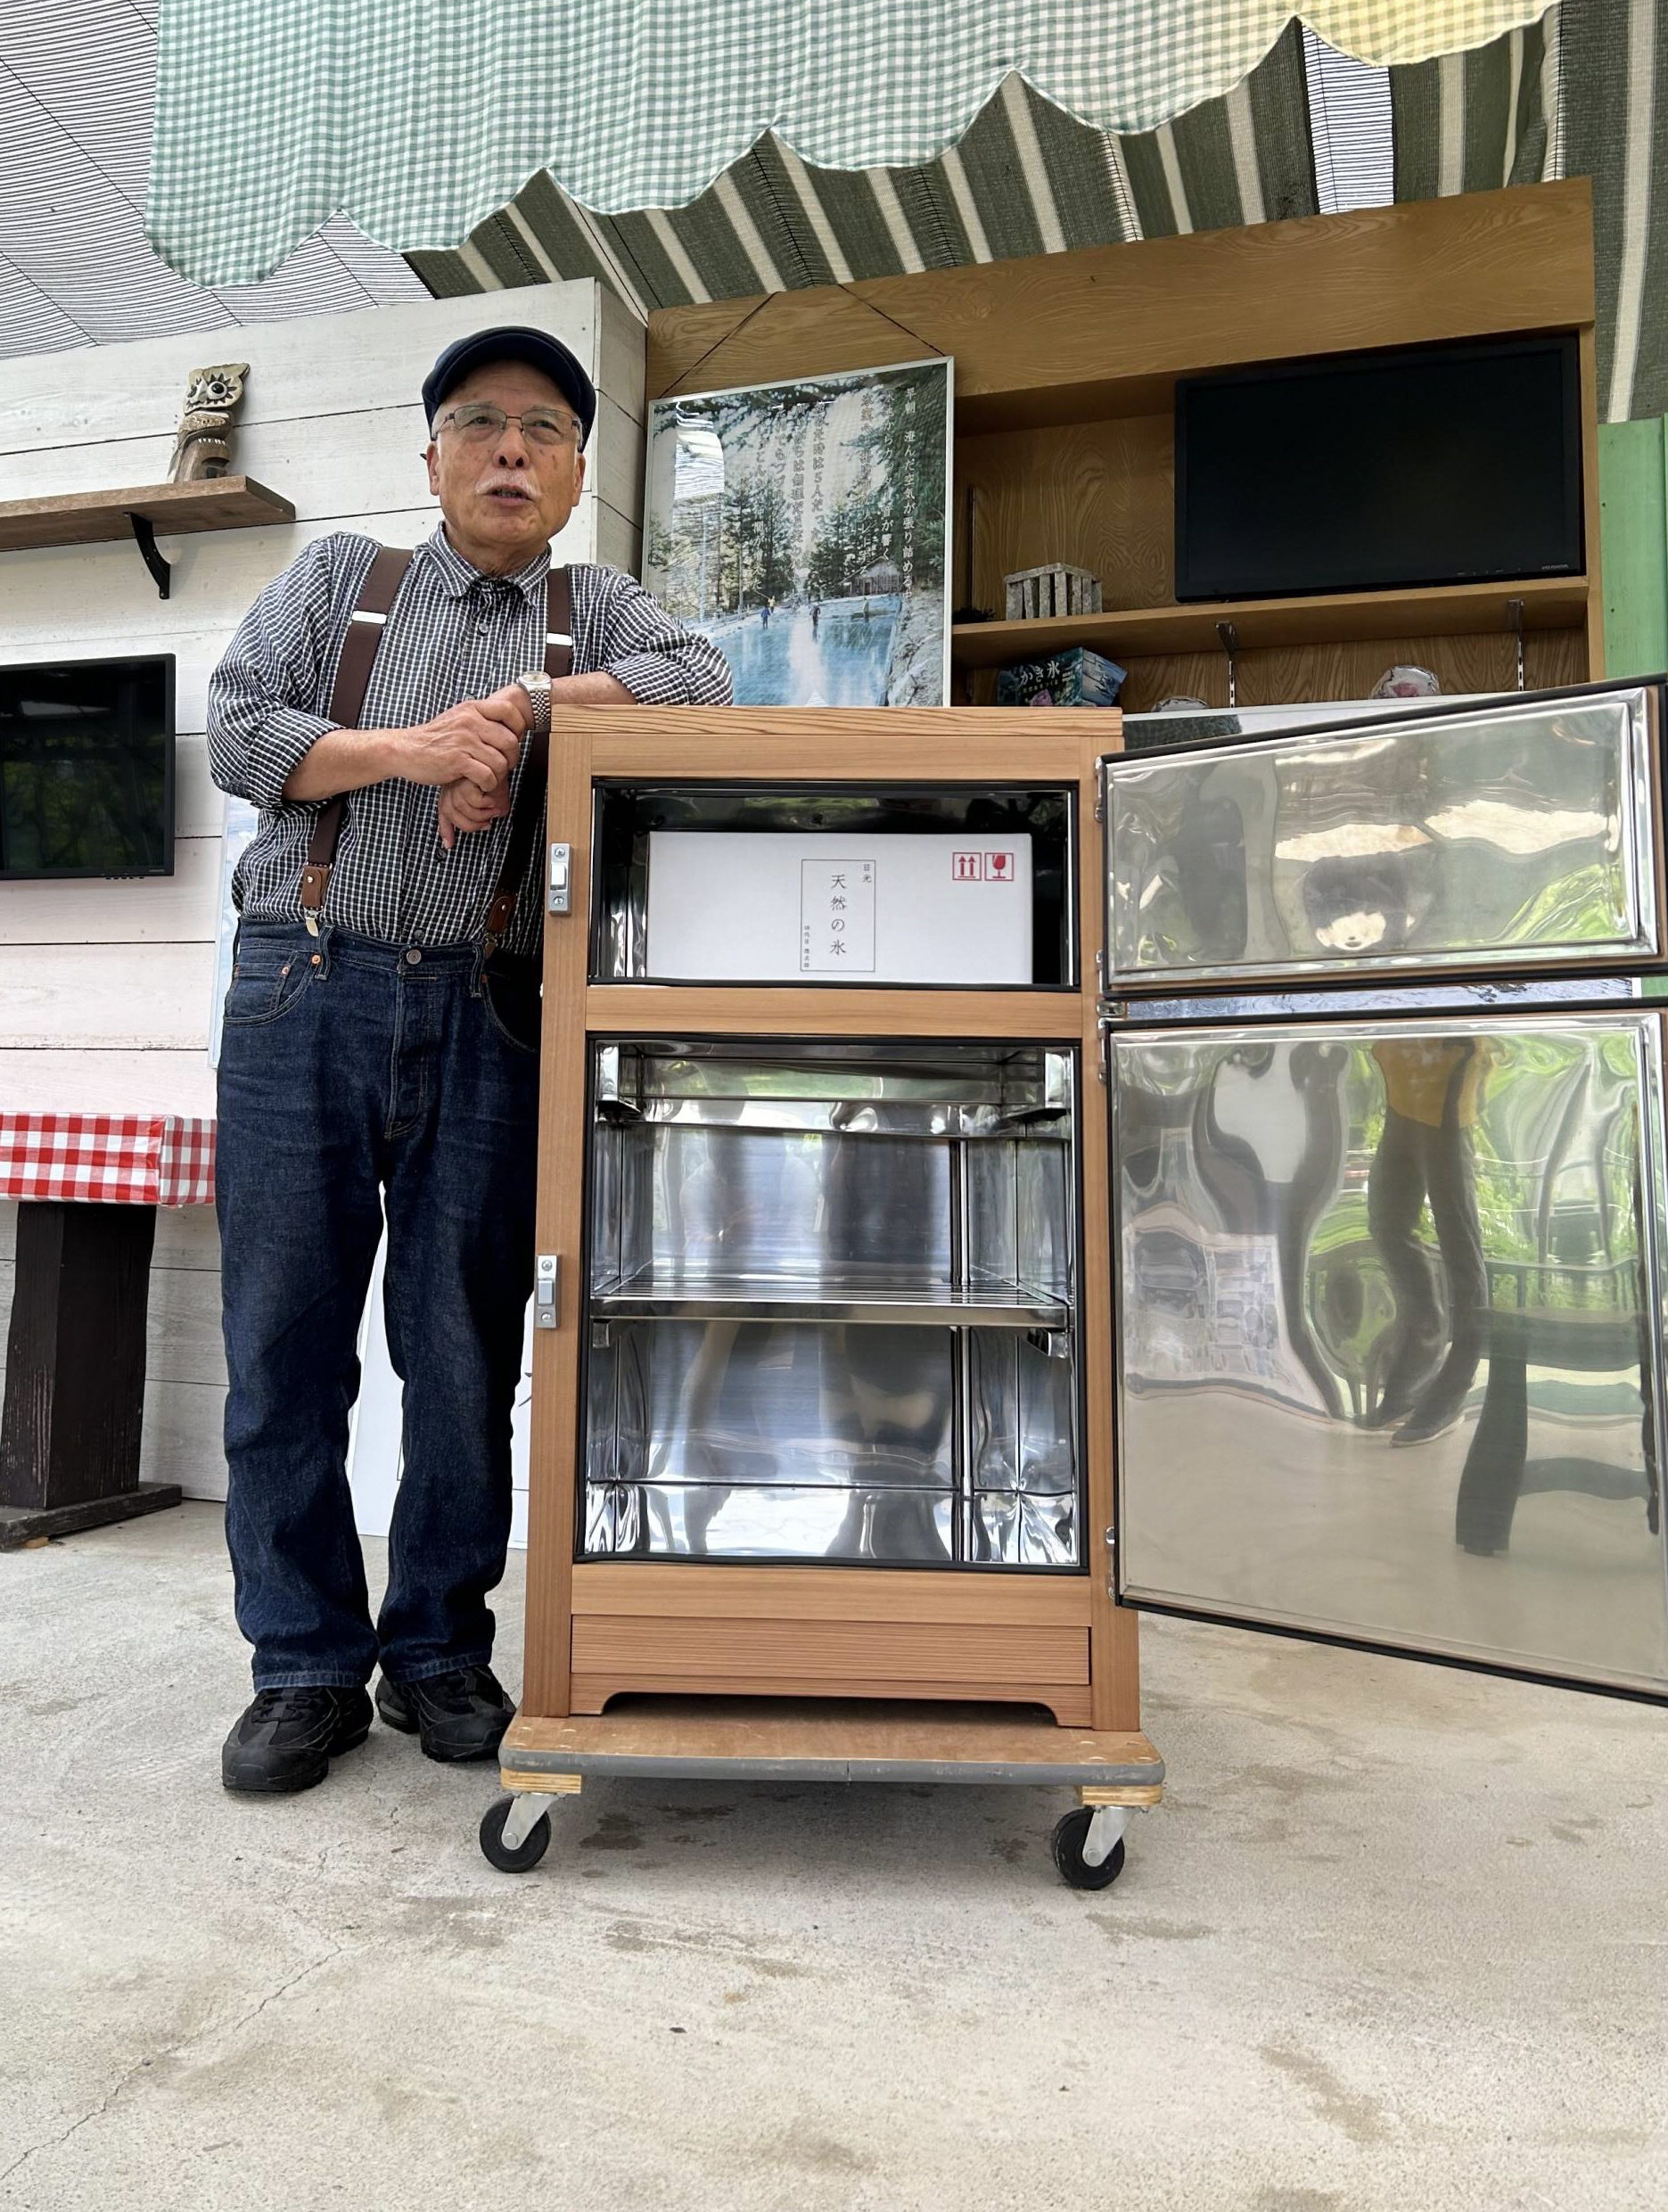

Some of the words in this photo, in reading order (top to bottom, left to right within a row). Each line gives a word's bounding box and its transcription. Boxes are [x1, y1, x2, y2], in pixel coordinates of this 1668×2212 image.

[904, 387, 916, 415] 早朝
[1019, 661, 1060, 686] かき氷
[862, 864, 872, 883] 日光
[830, 874, 847, 955] 天然の氷
